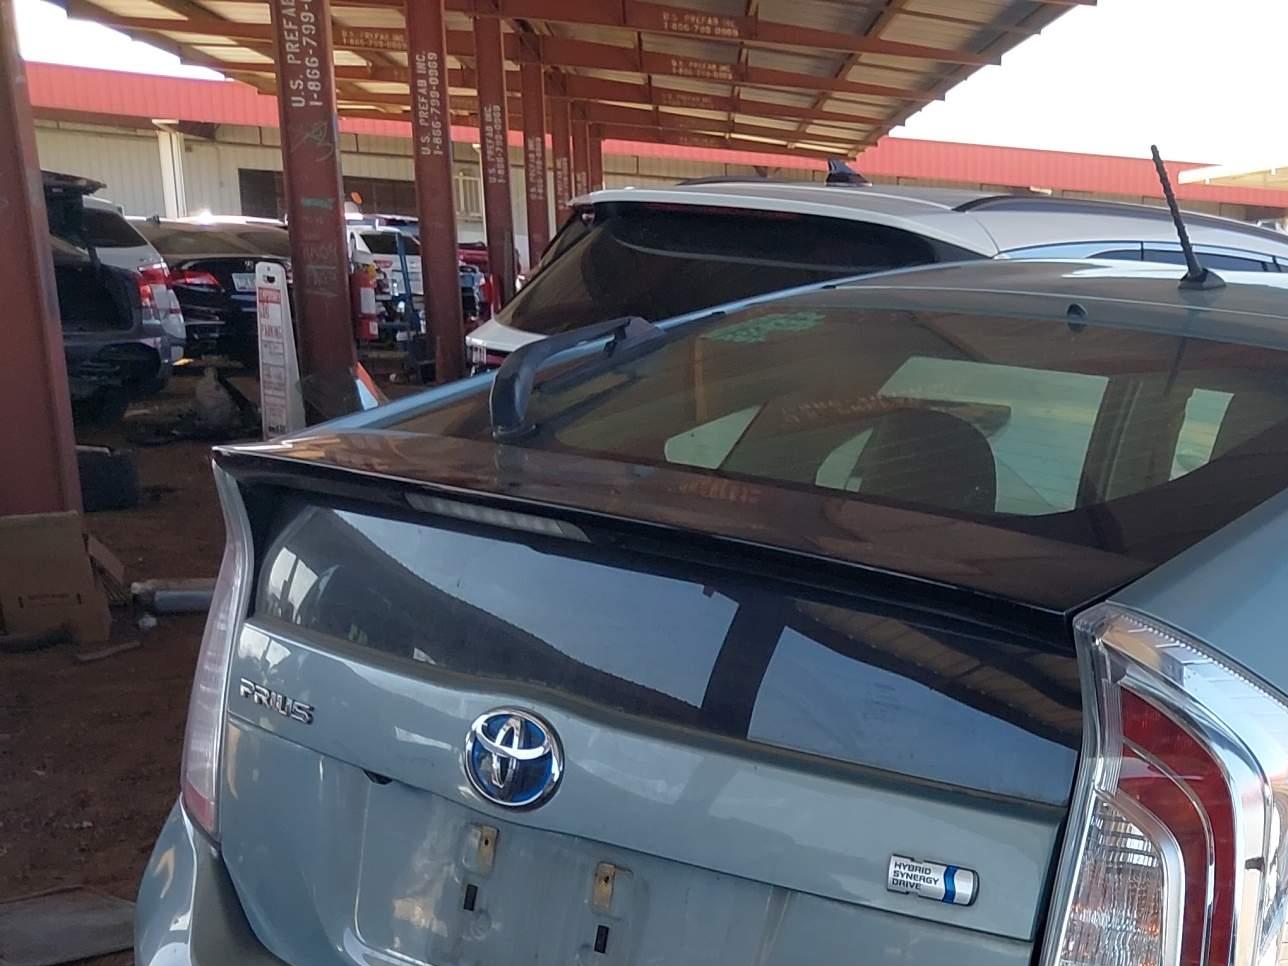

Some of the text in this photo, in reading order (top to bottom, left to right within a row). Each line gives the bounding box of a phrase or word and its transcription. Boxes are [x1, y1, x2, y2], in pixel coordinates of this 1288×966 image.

[300, 0, 323, 106] 1-866-799-
[290, 74, 306, 107] U.S.
[417, 78, 430, 126] PREFAB
[239, 677, 316, 725] PRIUS
[892, 870, 940, 886] SYNERGY
[892, 878, 922, 889] DRIVE
[894, 861, 932, 875] HYBRID
